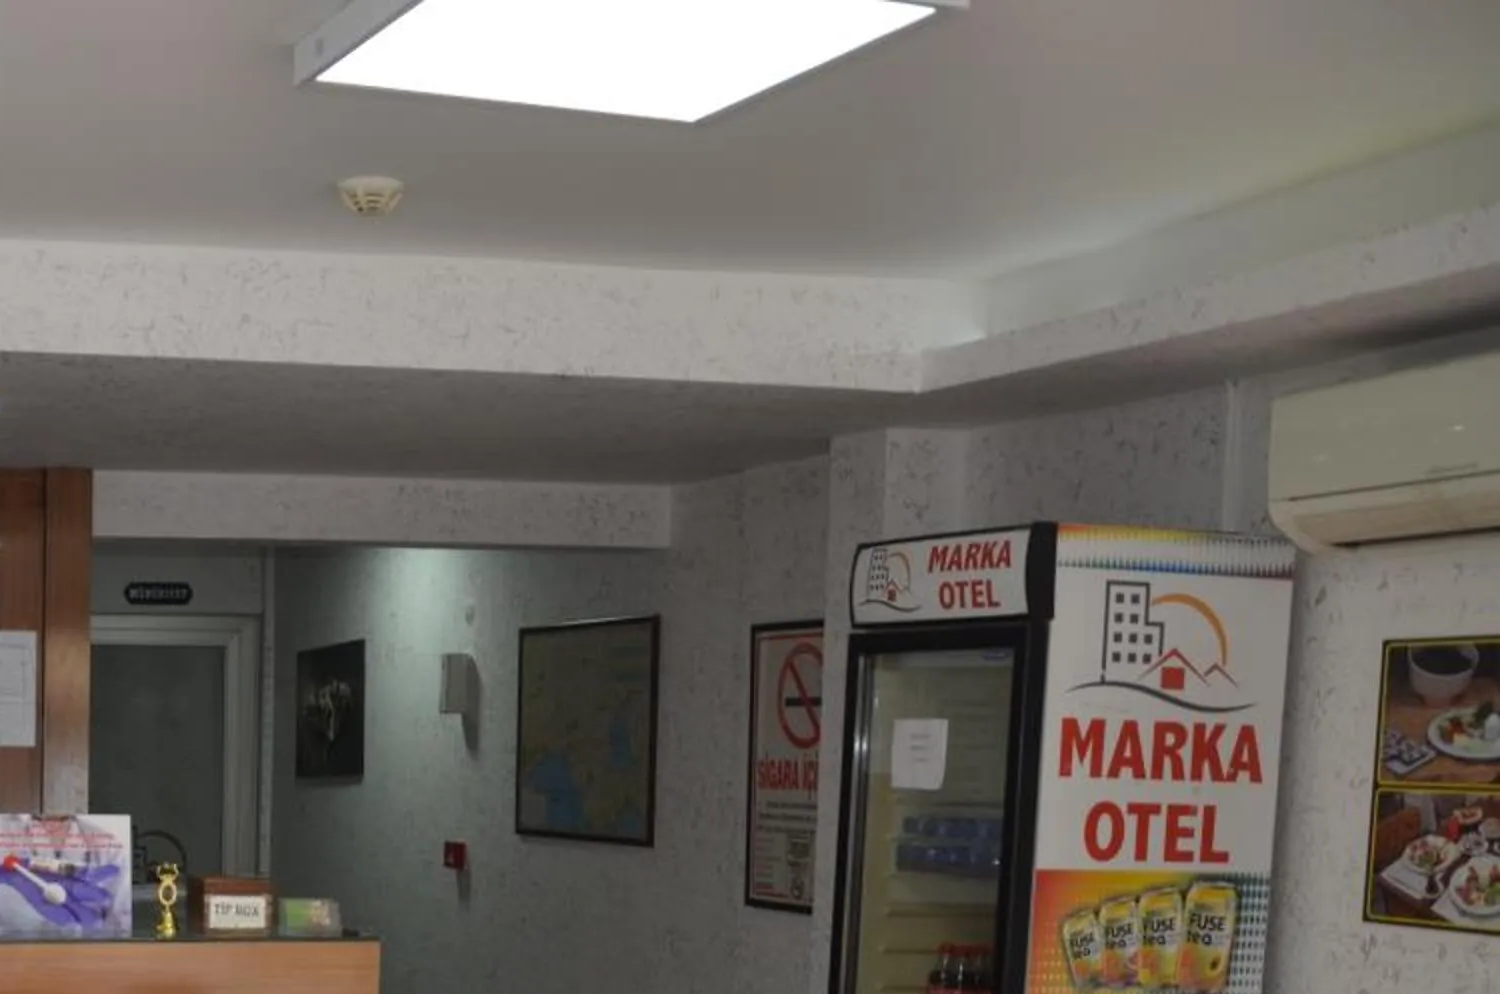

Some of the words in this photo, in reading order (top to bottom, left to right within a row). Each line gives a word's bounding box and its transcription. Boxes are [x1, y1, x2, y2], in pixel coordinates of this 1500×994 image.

[928, 540, 1012, 573] MARKA
[938, 580, 1001, 609] OTEL
[1058, 717, 1263, 783] MARKA
[1083, 801, 1229, 863] OTEL
[1189, 912, 1226, 932] FUSE
